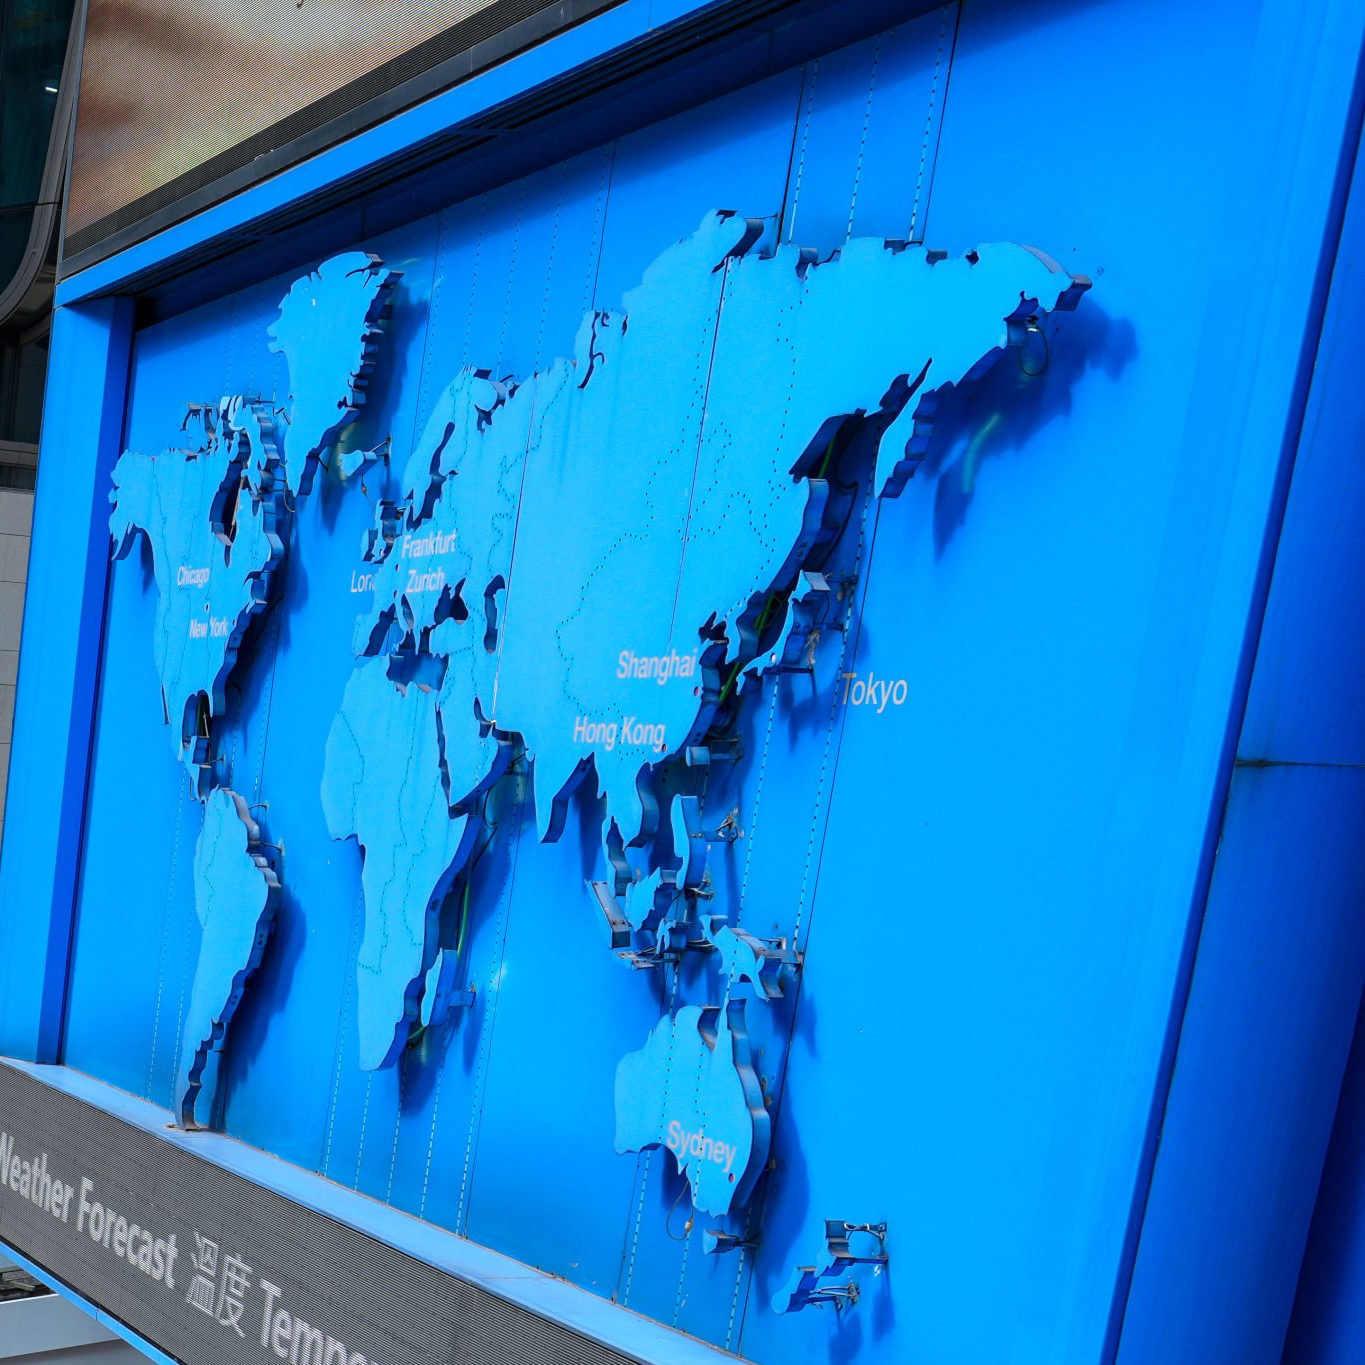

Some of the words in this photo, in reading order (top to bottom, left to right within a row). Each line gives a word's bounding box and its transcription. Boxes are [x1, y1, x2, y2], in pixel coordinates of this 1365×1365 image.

[402, 529, 456, 559] Frankfurt
[178, 566, 210, 588] Chicago
[351, 570, 374, 592] Lon
[406, 567, 445, 593] Zurich
[190, 619, 207, 638] New
[210, 617, 227, 637] York
[617, 649, 698, 685] Shanghai
[841, 672, 907, 714] Tokyo
[573, 716, 616, 750] Hong
[621, 716, 665, 752] Kong
[667, 1120, 737, 1173] Sydney
[77, 1176, 178, 1290] Forecast
